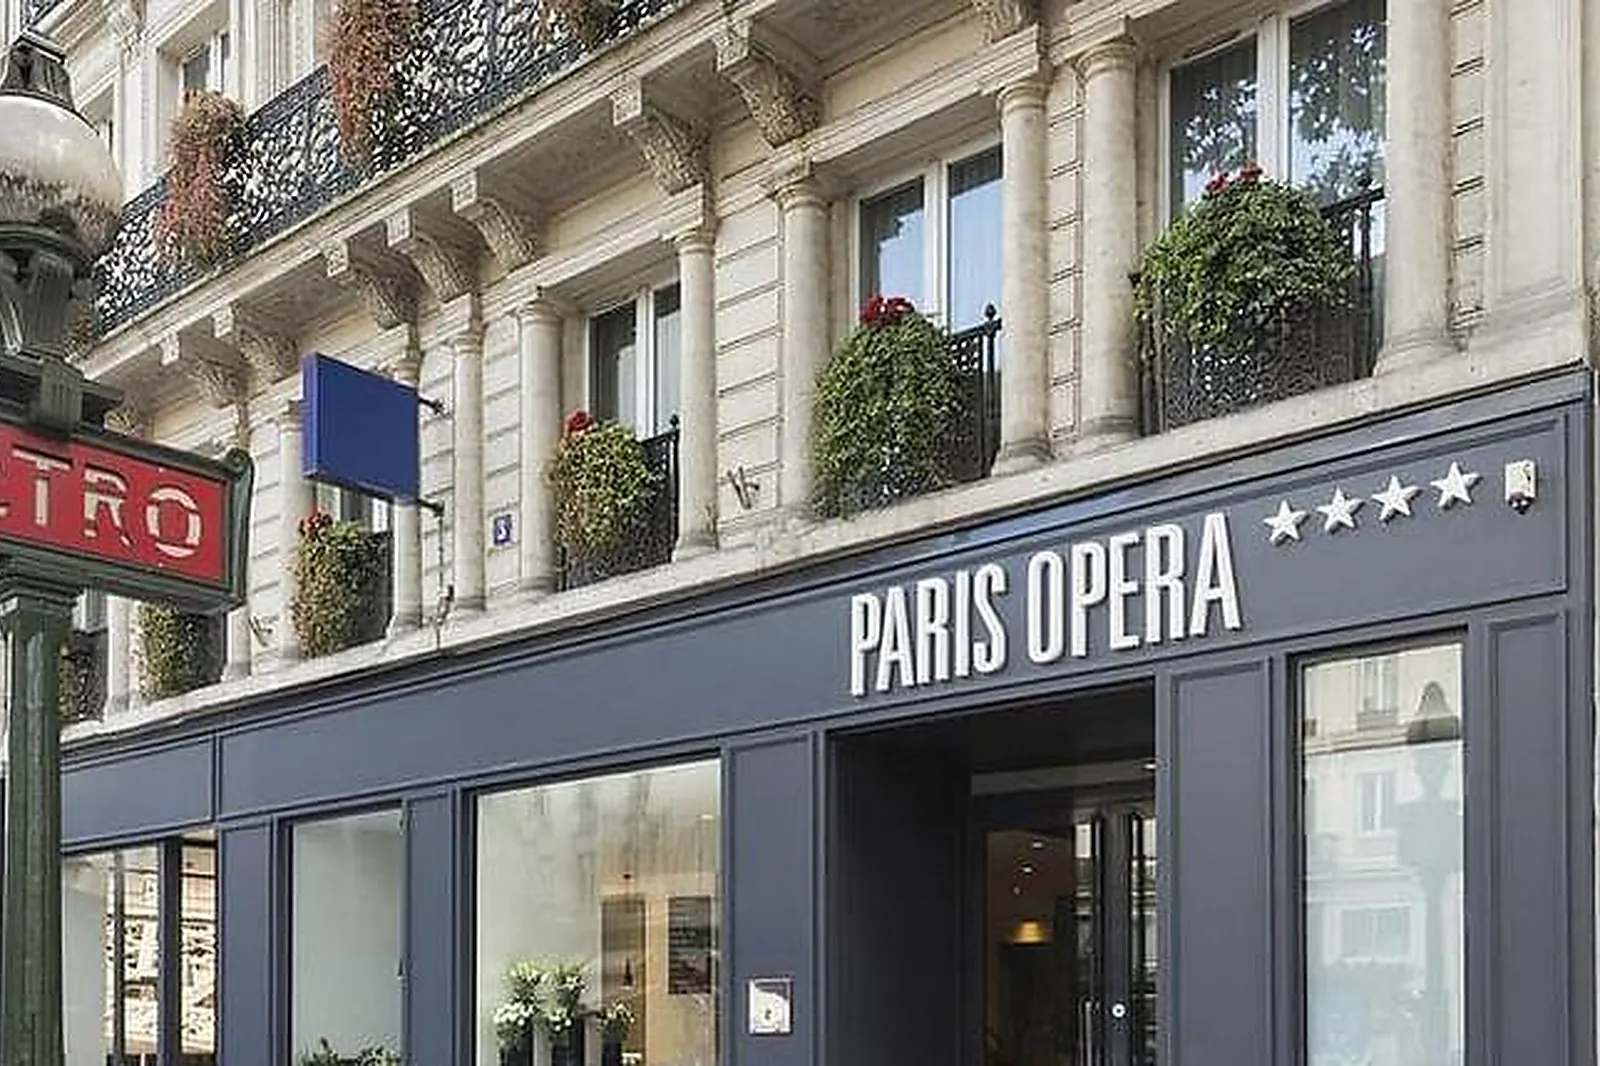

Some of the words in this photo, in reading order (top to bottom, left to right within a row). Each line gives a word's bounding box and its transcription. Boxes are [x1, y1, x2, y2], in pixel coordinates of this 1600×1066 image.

[0, 448, 201, 557] TRO
[850, 563, 1008, 697] PARIS
[1026, 511, 1242, 664] OPERA
